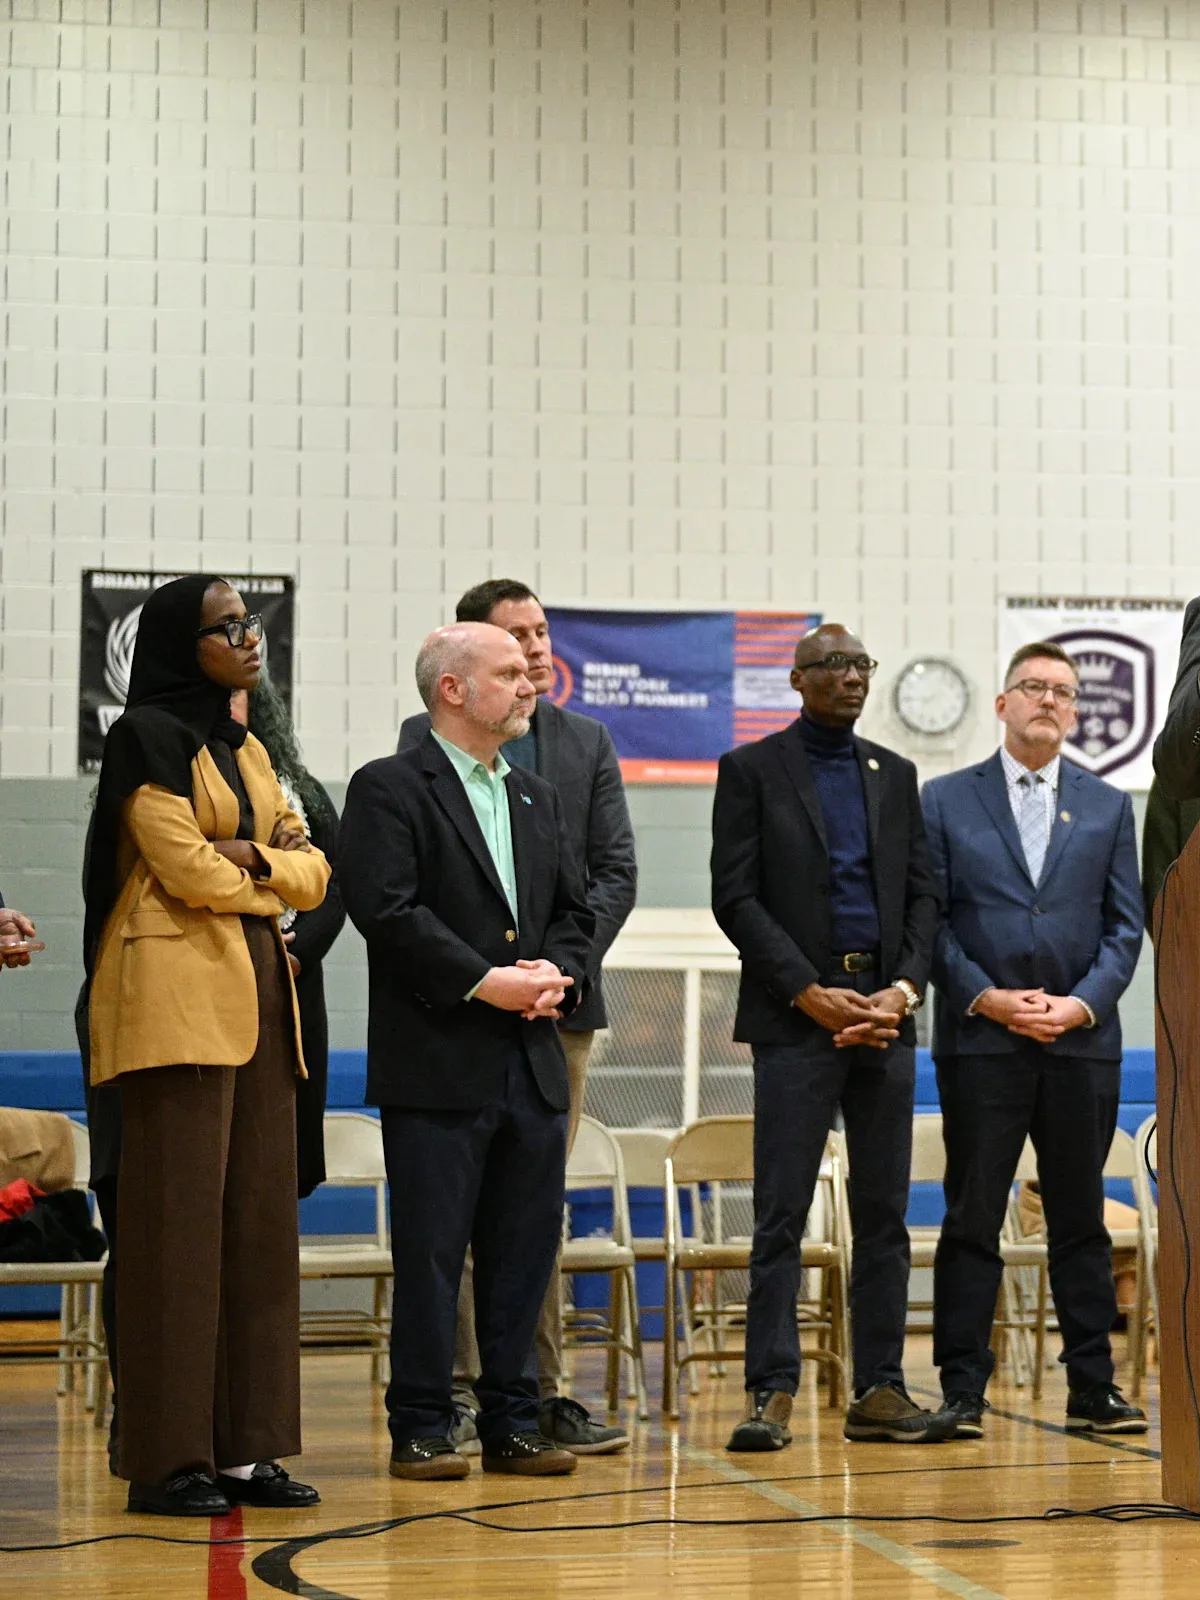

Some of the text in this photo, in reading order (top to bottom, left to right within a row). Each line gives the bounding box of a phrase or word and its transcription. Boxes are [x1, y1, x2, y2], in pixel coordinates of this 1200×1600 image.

[92, 573, 149, 589] BRIAN
[1007, 597, 1185, 612] BRIAN COYLE CENTER
[583, 663, 640, 677] RISING
[583, 678, 670, 692] NEW YORK
[583, 691, 708, 708] ROAD RUNNERS
